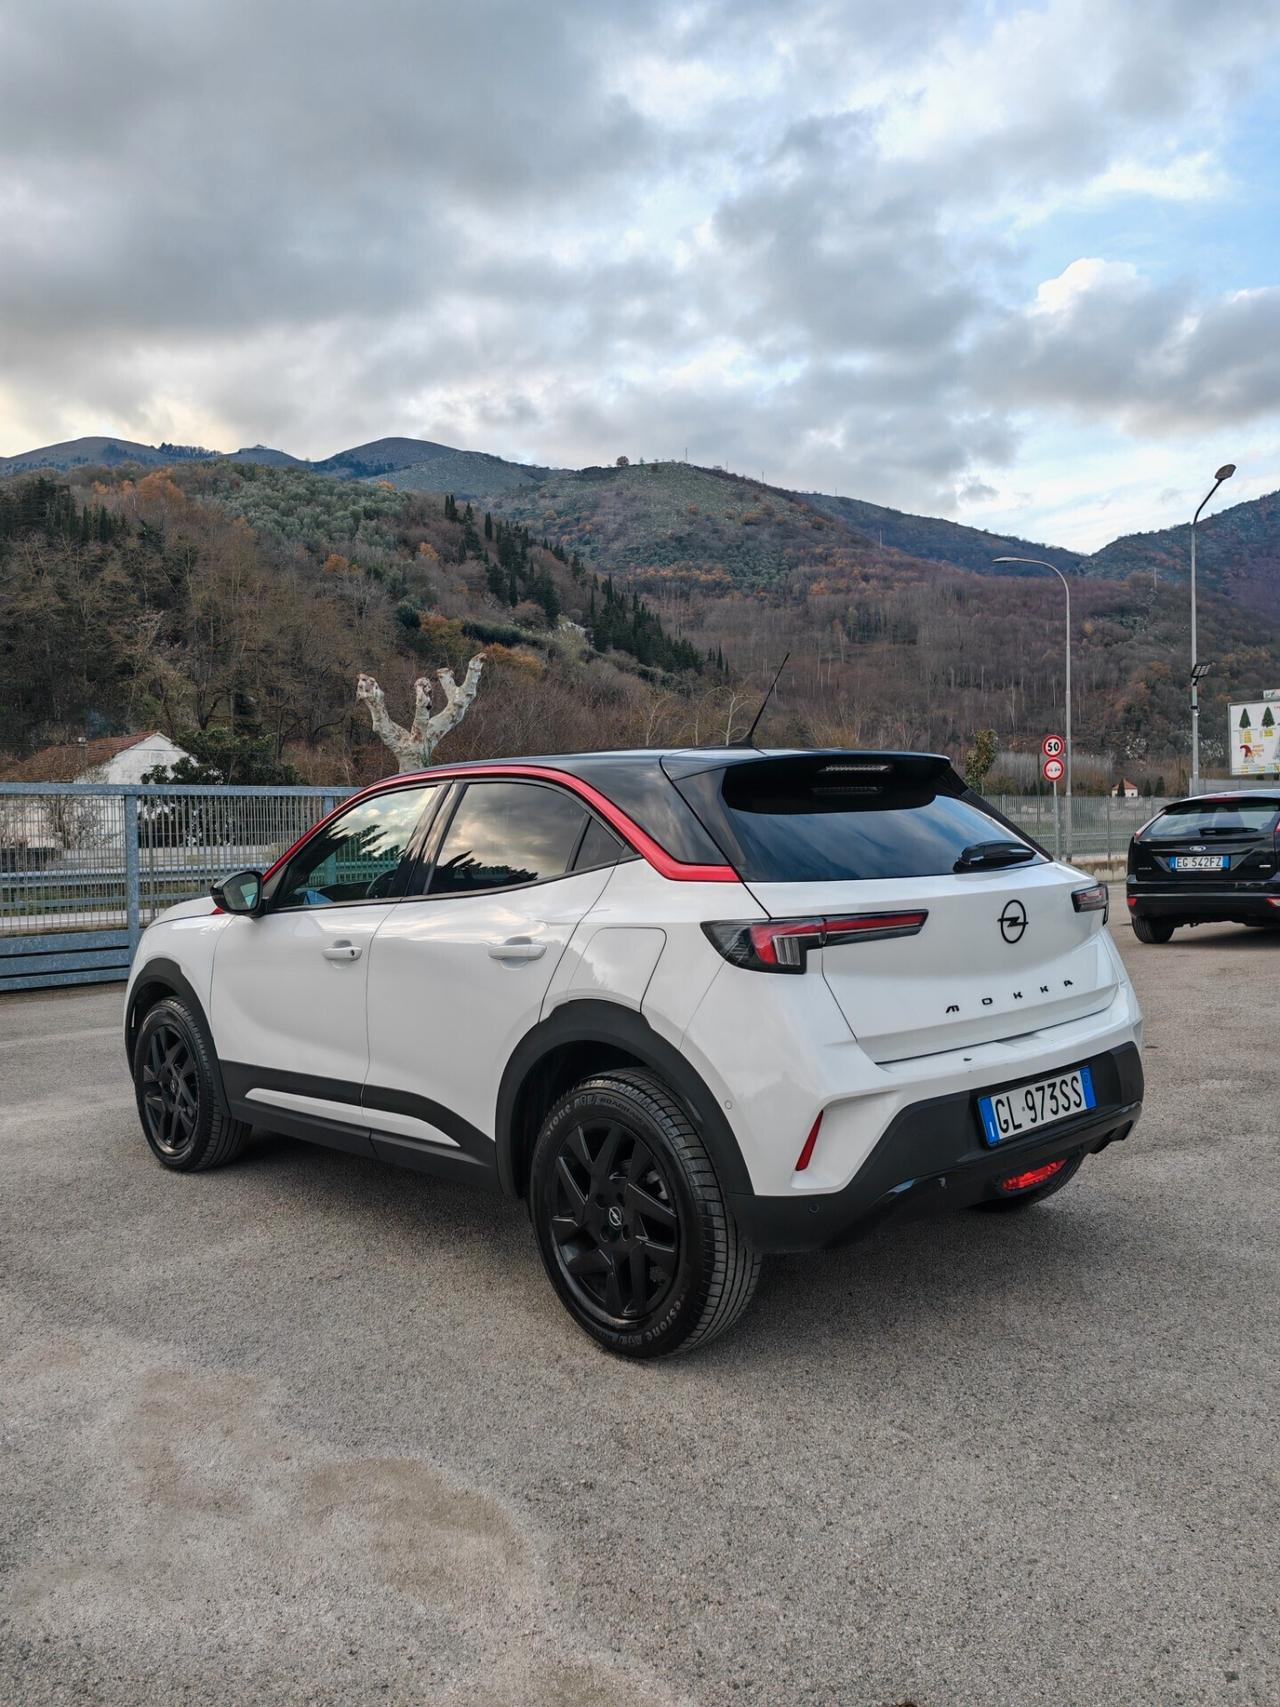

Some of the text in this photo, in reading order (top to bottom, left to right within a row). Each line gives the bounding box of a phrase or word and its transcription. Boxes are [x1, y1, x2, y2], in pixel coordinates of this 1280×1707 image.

[1047, 741, 1060, 752] 50
[1176, 857, 1188, 868] EG
[1191, 856, 1222, 868] 542FZ
[945, 979, 1073, 1014] MOKKA
[995, 1075, 1082, 1134] GL 973SS
